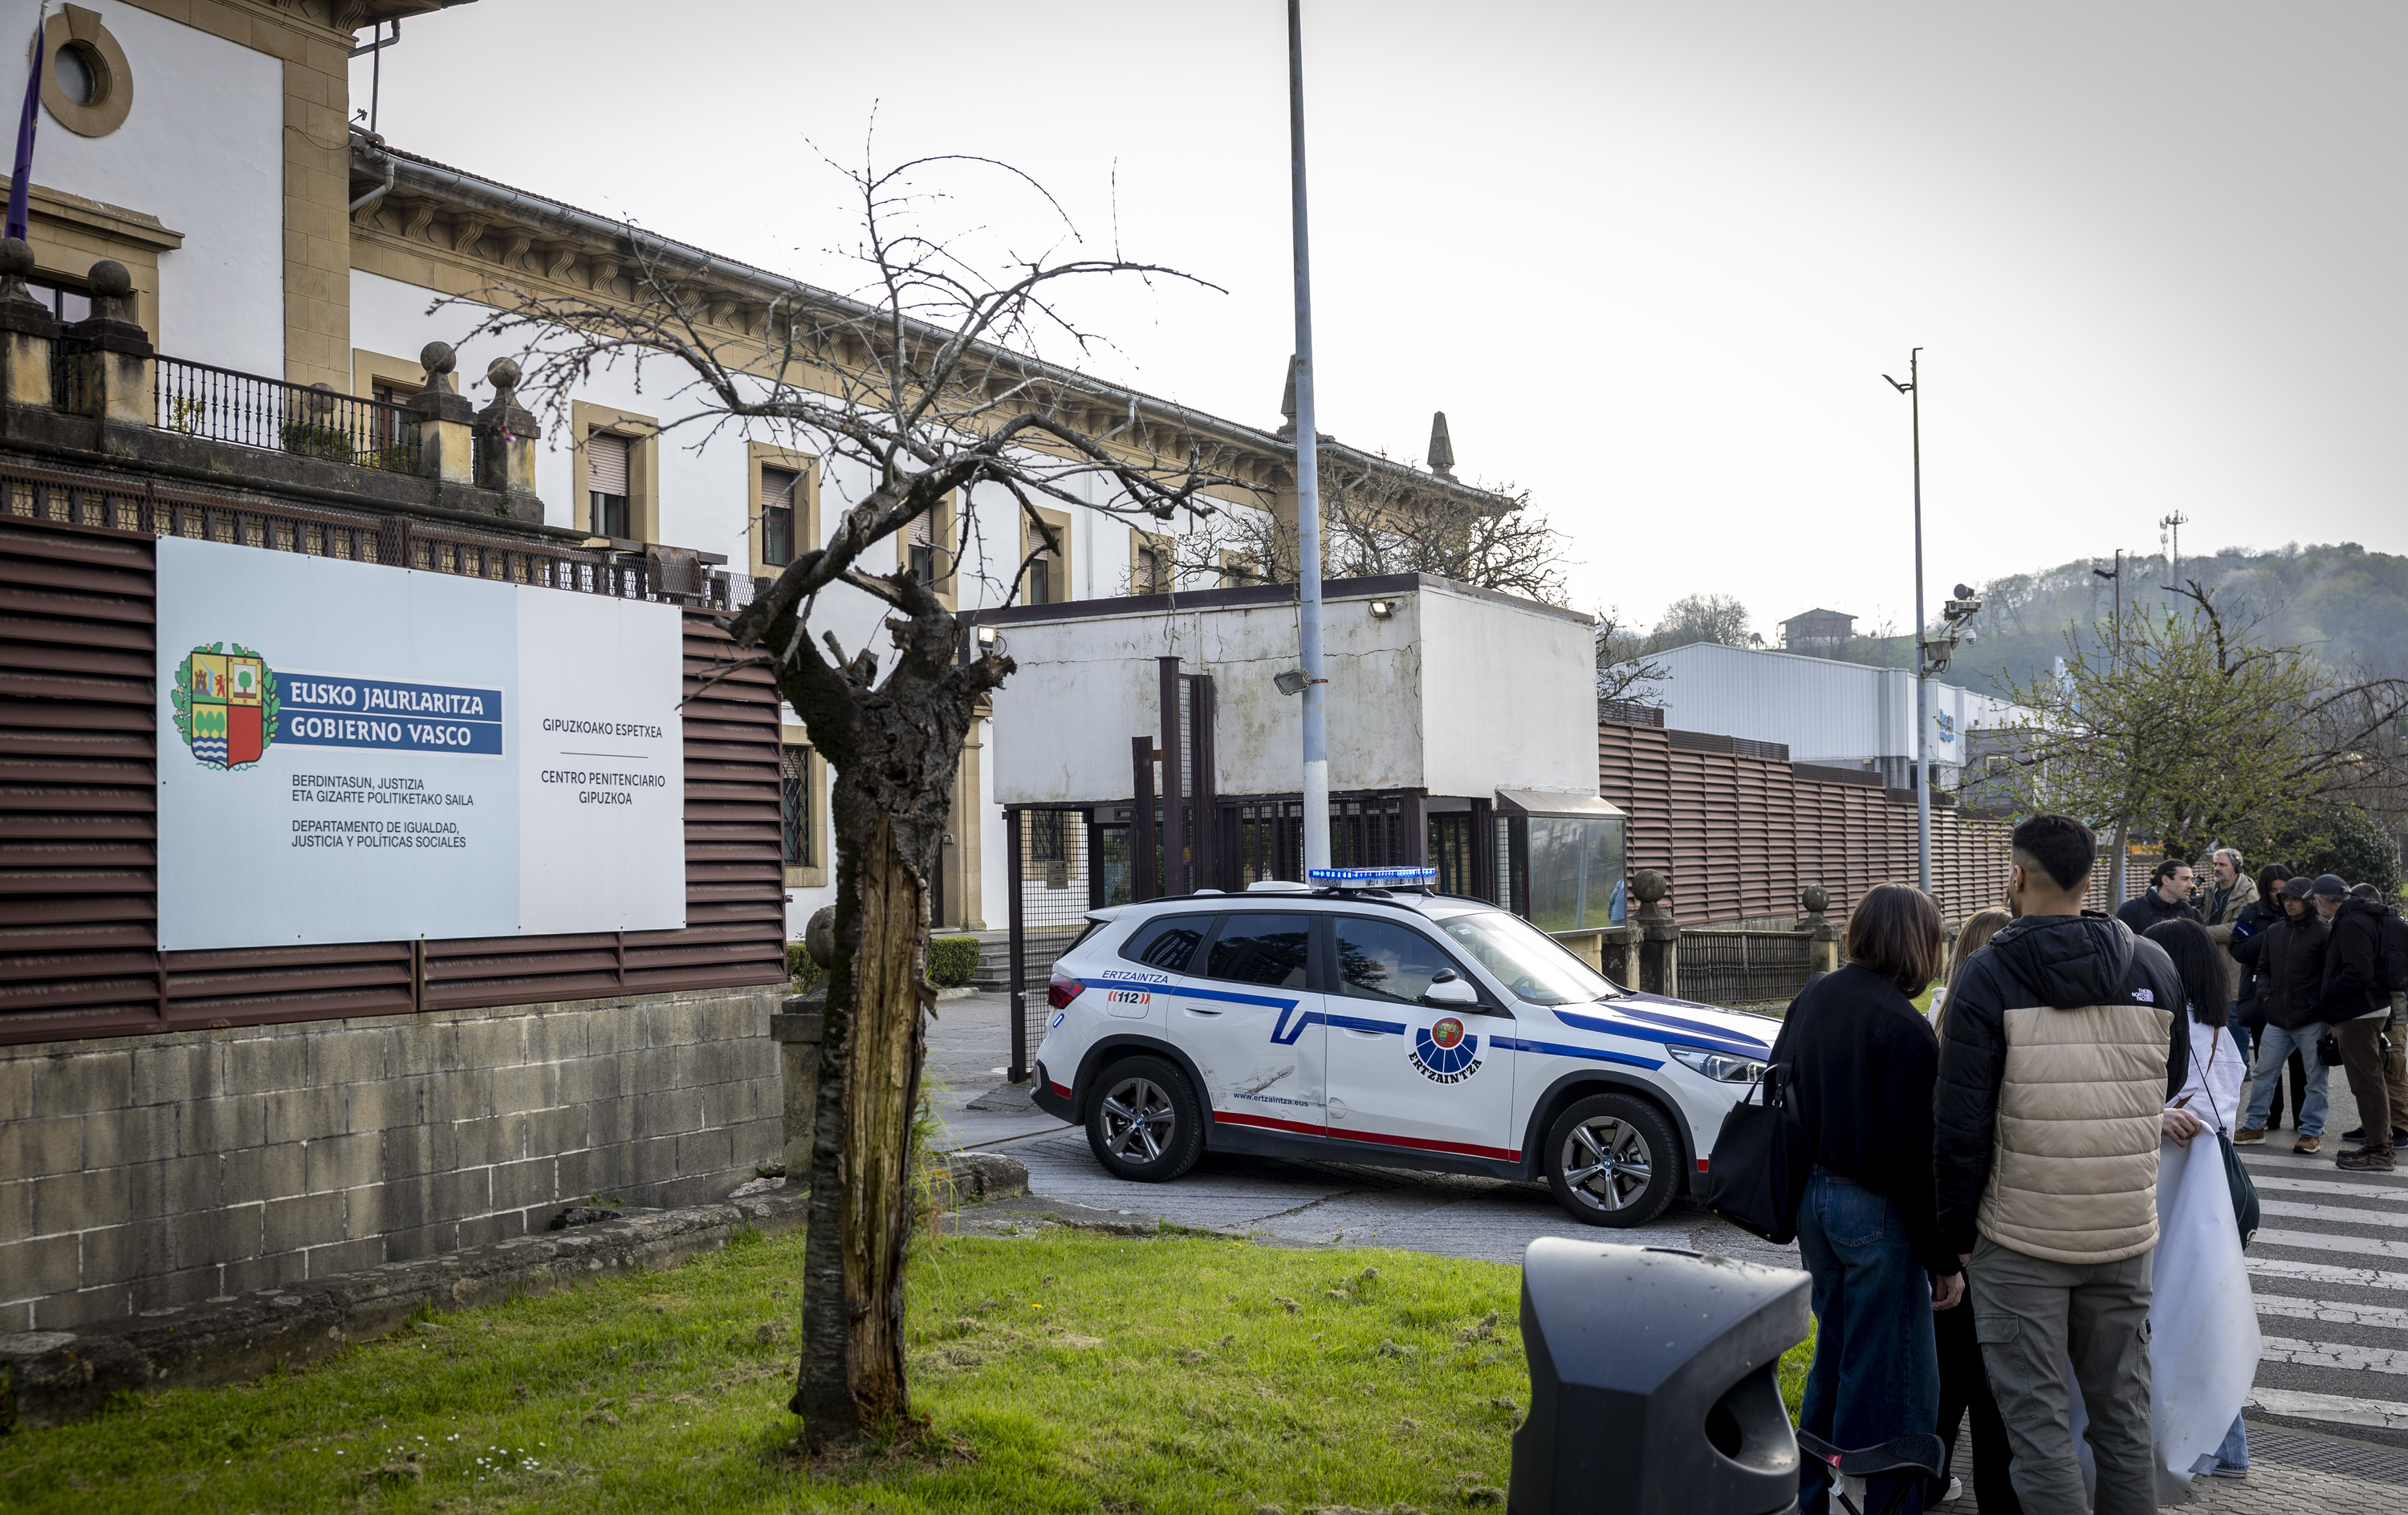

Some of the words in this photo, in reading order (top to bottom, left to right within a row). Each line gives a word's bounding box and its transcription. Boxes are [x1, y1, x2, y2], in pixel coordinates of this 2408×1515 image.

[290, 681, 356, 706] EUSKO
[362, 688, 484, 716] JAURLARITZA
[291, 717, 402, 742] GOBIERNO
[407, 724, 471, 746] VASCO
[543, 718, 613, 736] GIPUZKOAKO
[616, 723, 663, 739] ESPETXEA
[292, 774, 376, 790] BERDINTASUN,
[377, 778, 425, 790] JUSTIZIA
[541, 770, 587, 785] CENTRO
[589, 772, 666, 787] PENITENCIARIO
[292, 790, 314, 802] ETA
[316, 790, 364, 803] GIZARTE
[368, 792, 443, 806] POLITIKETAKO
[445, 794, 474, 806] SAILA
[579, 790, 633, 805] GIPUZKOA
[292, 820, 384, 833] DEPARTAMENTO
[386, 821, 401, 833] DE
[404, 822, 460, 835] IGUALDAD,
[291, 835, 344, 847] JUSTICIA
[346, 835, 354, 847] Y
[357, 833, 413, 848] POLÍTICAS
[415, 836, 466, 848] SOCIALES
[1102, 969, 1169, 984] ERTZAINTZA
[1408, 1051, 1483, 1084] ERTZAINTZA
[1233, 1092, 1309, 1107] www.ertzaintza.eus
